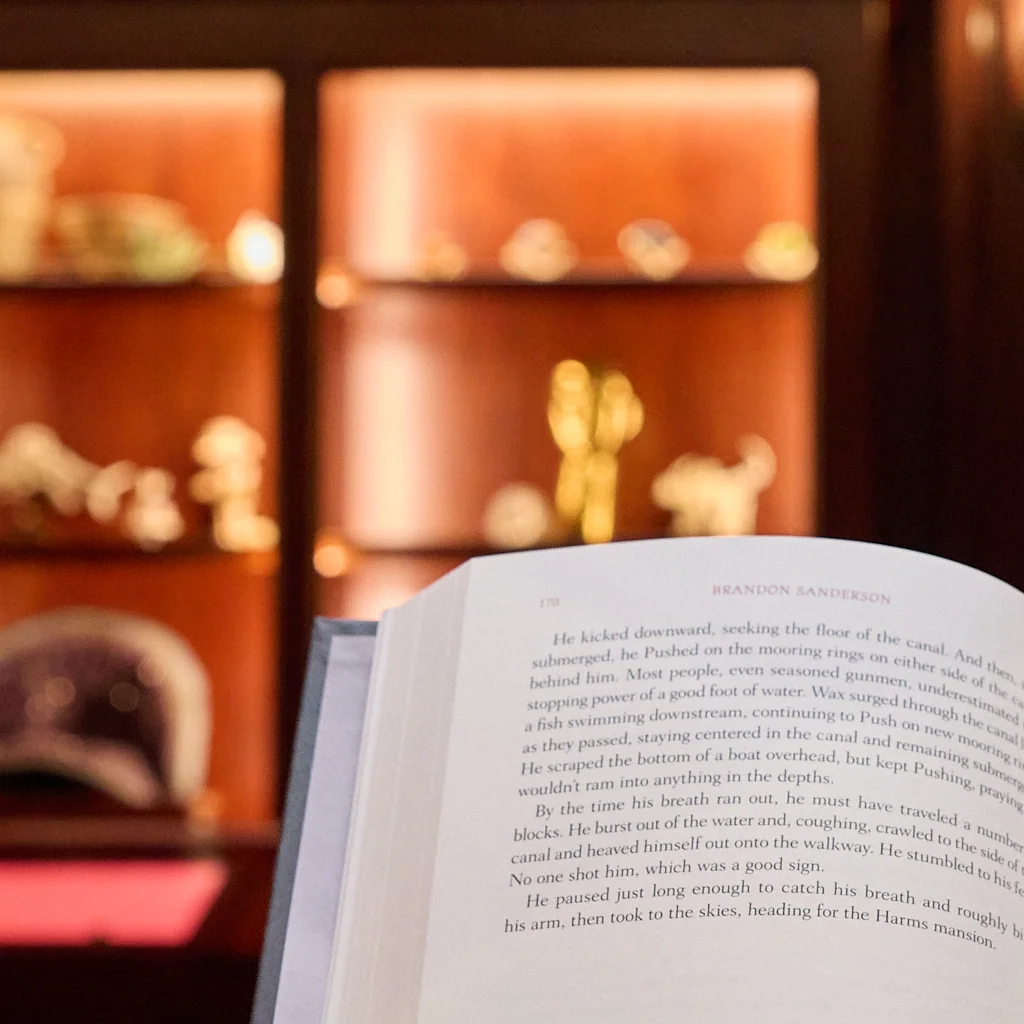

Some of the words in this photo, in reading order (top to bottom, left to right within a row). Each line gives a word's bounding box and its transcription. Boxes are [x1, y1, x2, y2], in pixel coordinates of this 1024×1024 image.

[711, 583, 791, 597] BRANDON
[795, 585, 892, 605] SANDERSON
[521, 743, 538, 754] as
[541, 736, 574, 752] they
[577, 730, 634, 753] passed,
[636, 731, 691, 746] staying
[693, 724, 761, 741] centered
[765, 726, 781, 739] in
[785, 725, 811, 740] the
[815, 729, 858, 744] canal
[861, 733, 891, 748] and
[895, 740, 970, 769] remaining
[517, 778, 580, 797] wouldn’t
[584, 779, 614, 792] ram
[618, 775, 649, 789] into
[652, 769, 722, 789] anything
[725, 772, 741, 783] in
[746, 767, 773, 783] the
[776, 767, 836, 787] depths.
[508, 871, 533, 887] No
[535, 872, 564, 884] one
[567, 865, 600, 882] shot
[603, 863, 642, 879] him,
[644, 857, 692, 875] which
[696, 861, 726, 872] was
[730, 861, 740, 871] a
[743, 855, 783, 875] good
[787, 857, 827, 875] sign.
[503, 917, 526, 933] his
[529, 918, 567, 931] arm,
[570, 910, 605, 927] then
[609, 906, 643, 924] took
[647, 909, 664, 921] to
[667, 903, 694, 920] the
[697, 901, 744, 918] skies,
[746, 900, 812, 921] heading
[815, 901, 839, 918] for
[843, 904, 870, 921] the
[874, 907, 929, 930] Harms
[932, 922, 998, 950] mansion.
[525, 892, 549, 908] He
[554, 885, 610, 910] paused
[613, 886, 644, 904] just
[651, 882, 686, 900] long
[690, 878, 750, 898] enough
[757, 882, 774, 894] to
[780, 879, 825, 895] catch
[832, 880, 857, 897] his
[864, 883, 916, 905] breath
[921, 897, 951, 913] and
[956, 905, 1008, 935] roughly
